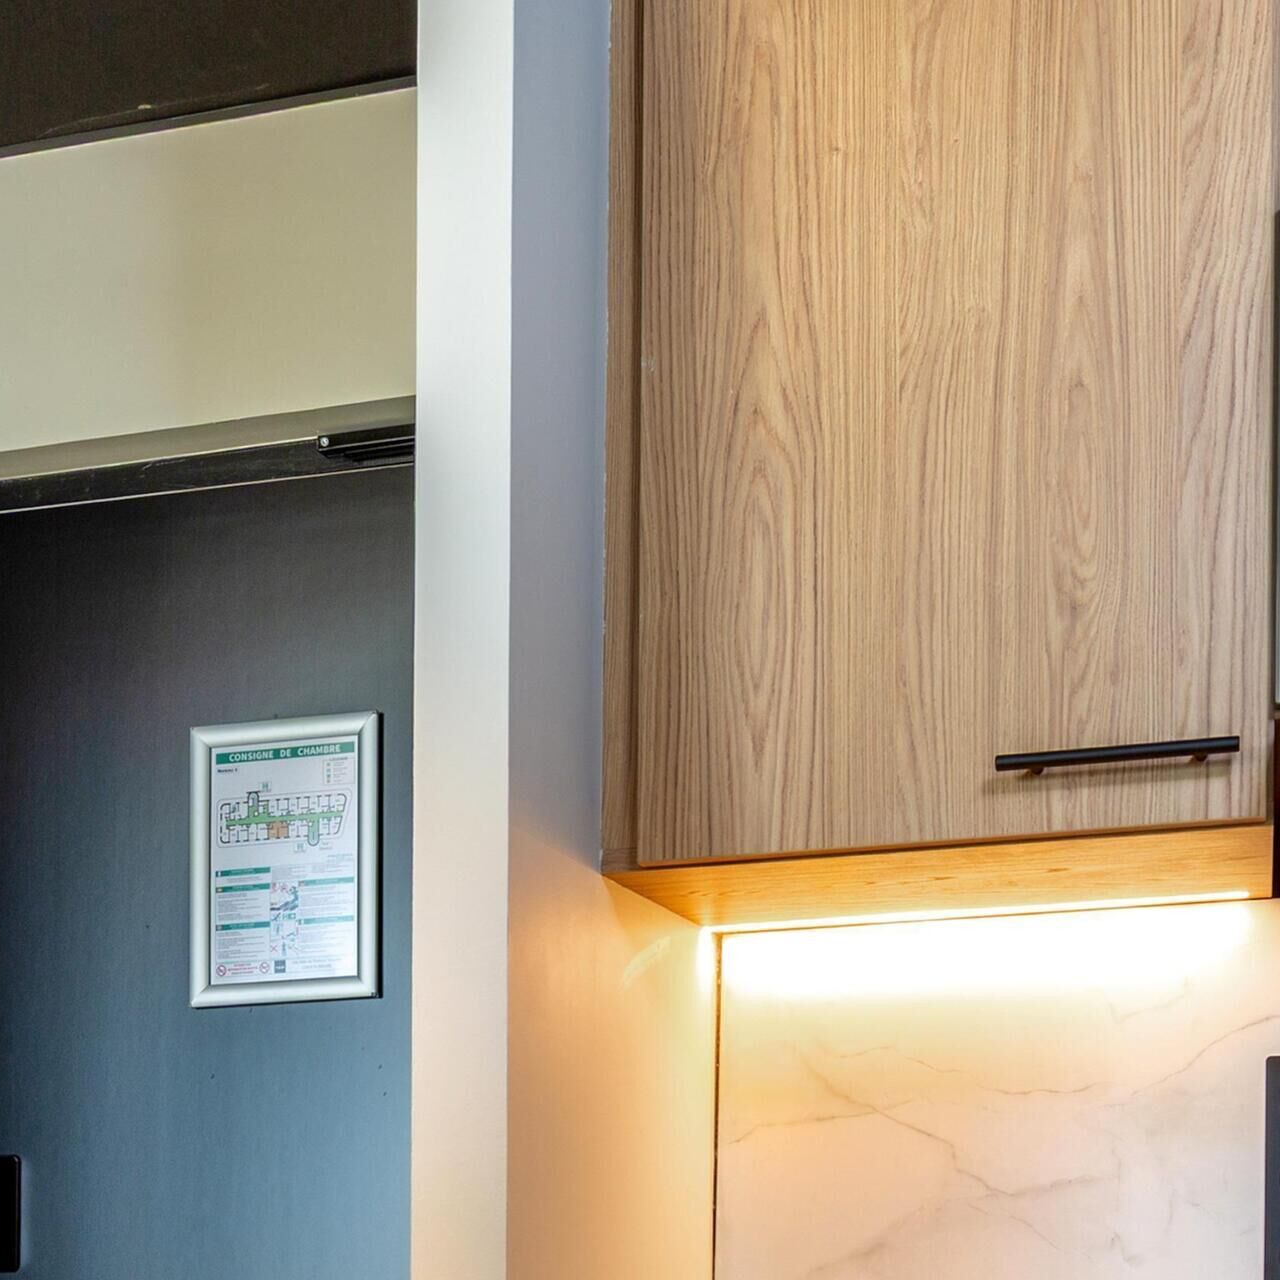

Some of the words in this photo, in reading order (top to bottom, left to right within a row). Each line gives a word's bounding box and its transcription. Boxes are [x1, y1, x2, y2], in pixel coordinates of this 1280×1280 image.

[228, 751, 274, 762] CONSIGNE
[279, 748, 291, 758] DE
[297, 744, 341, 756] CHAMBRE
